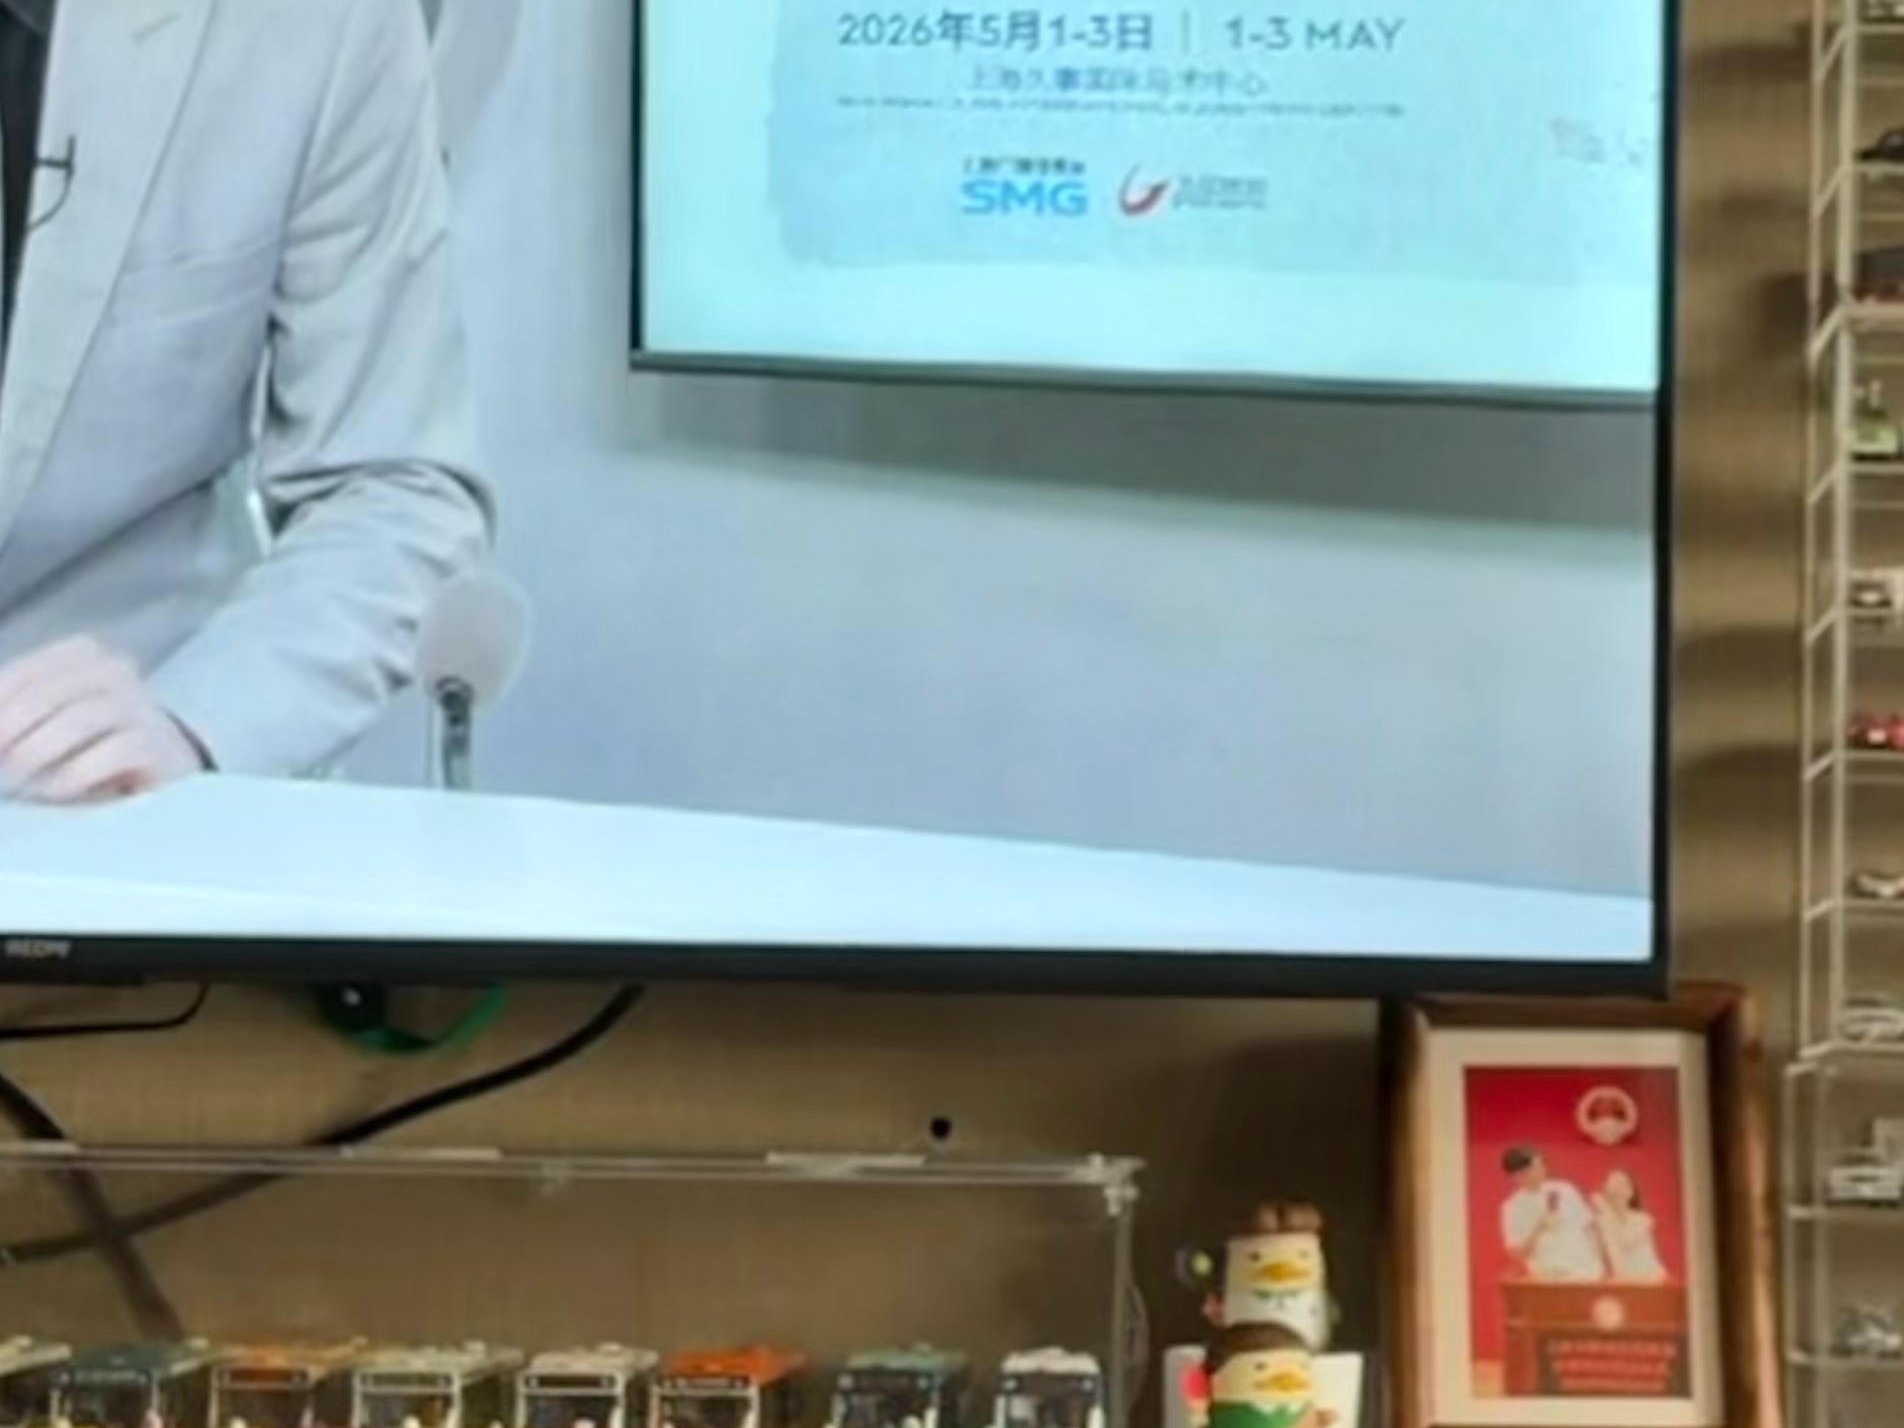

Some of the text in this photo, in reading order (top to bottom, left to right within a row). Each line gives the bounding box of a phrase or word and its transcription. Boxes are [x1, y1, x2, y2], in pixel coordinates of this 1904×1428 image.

[837, 7, 1407, 54] 2026年5月1-3日 1-3 MAY
[960, 178, 1088, 218] SMG
